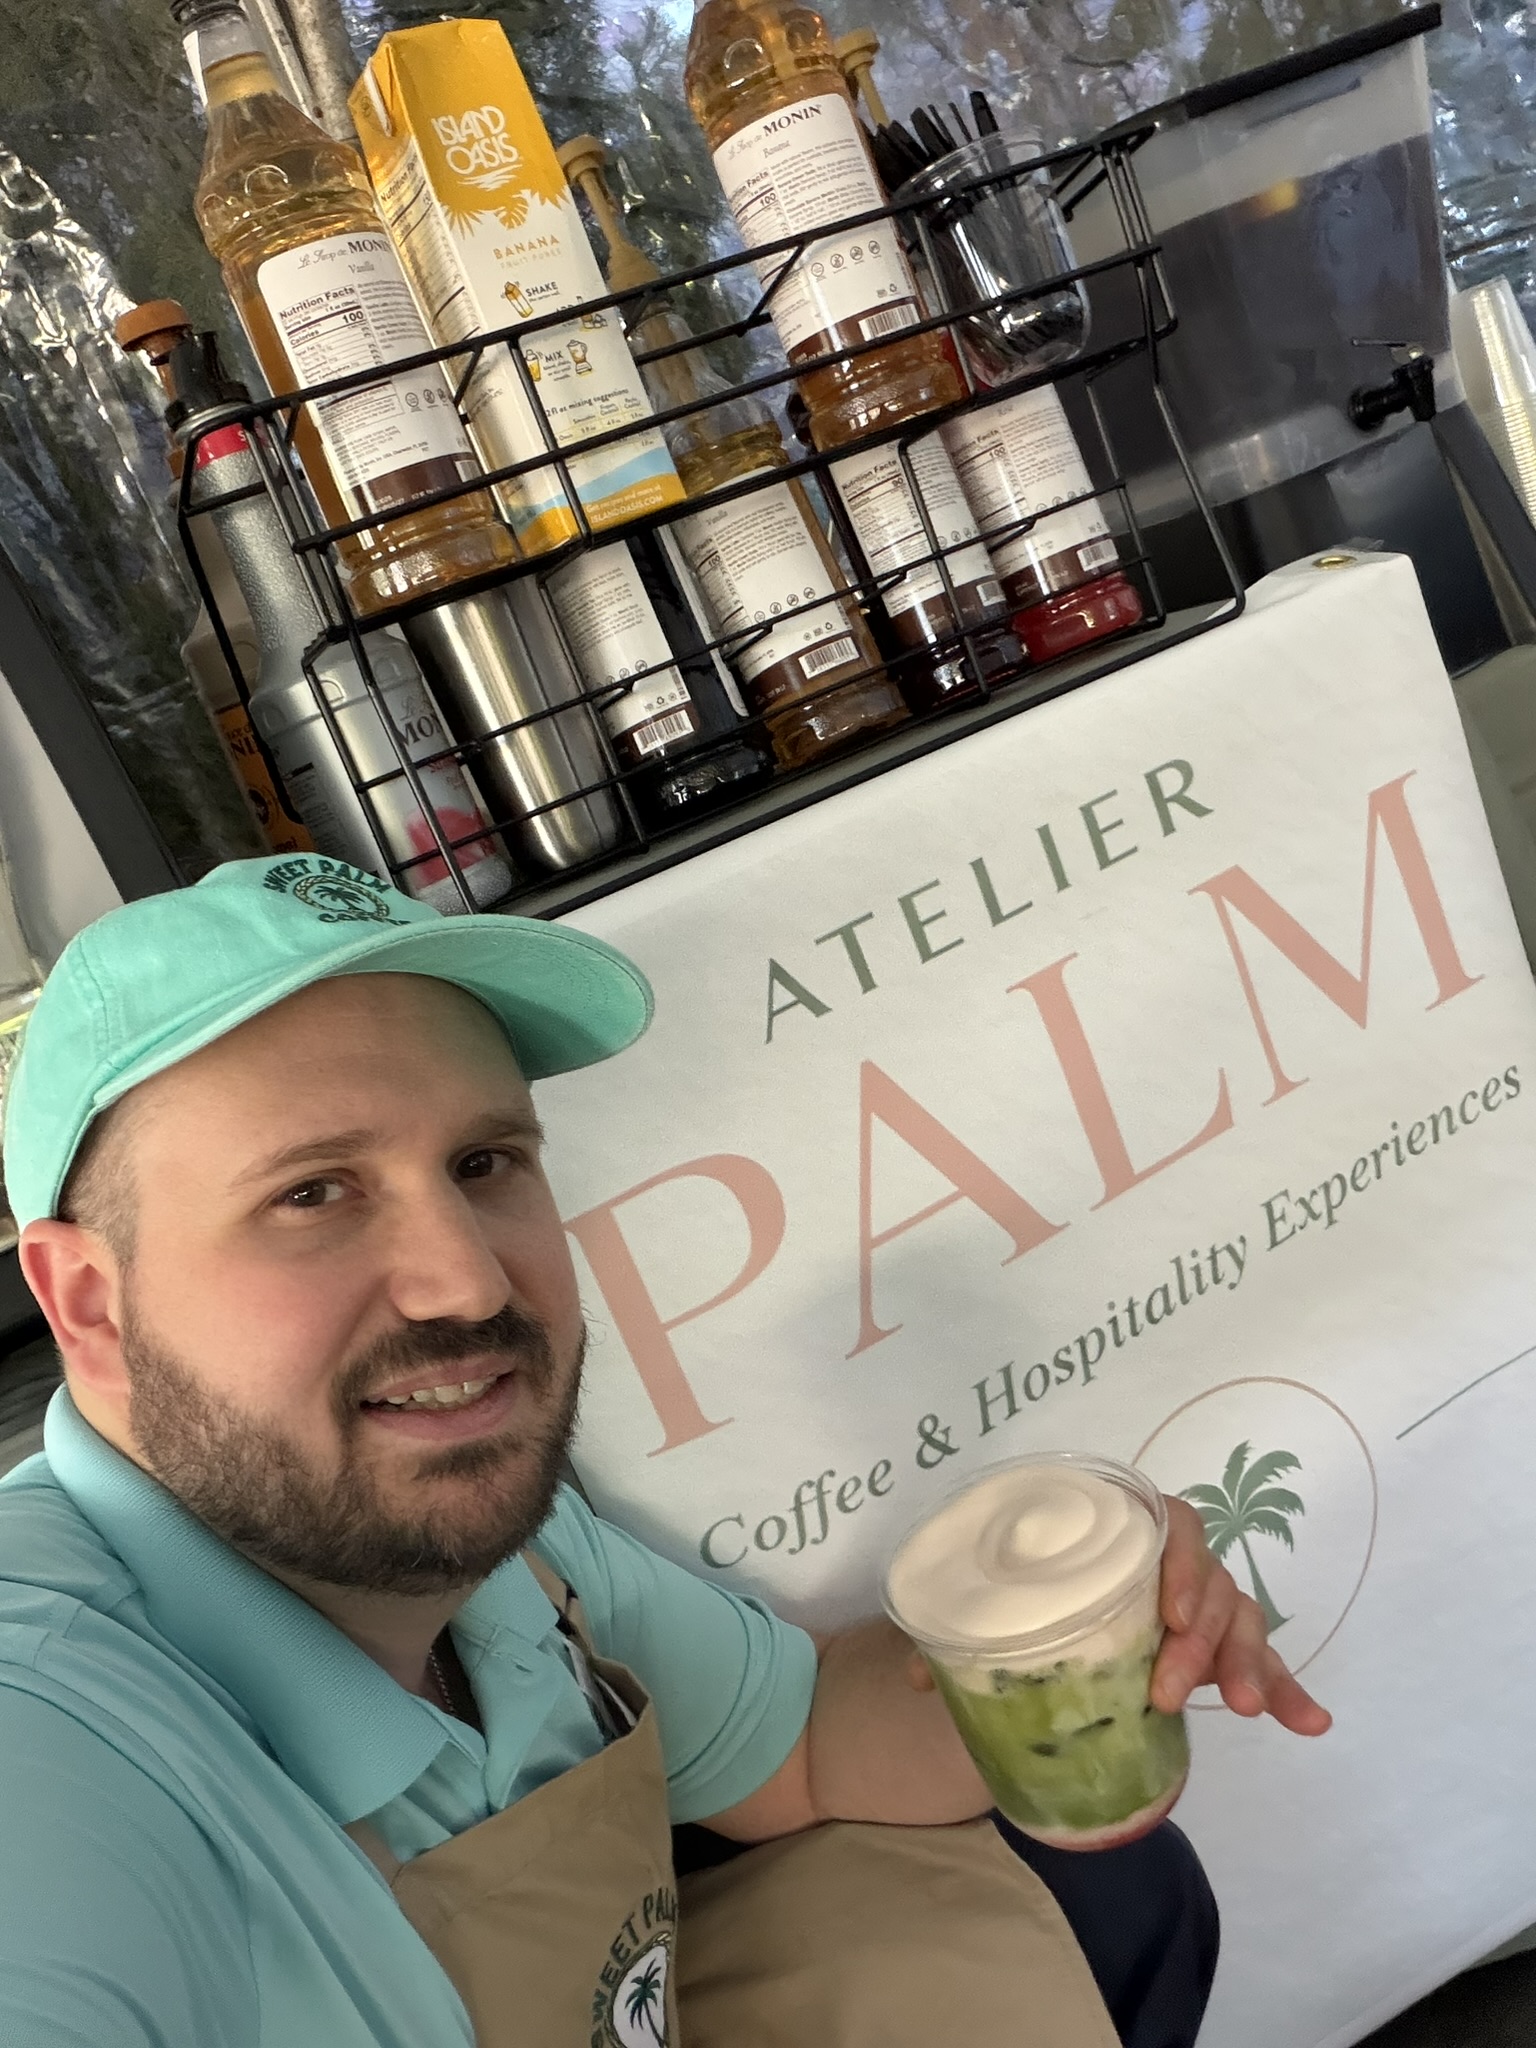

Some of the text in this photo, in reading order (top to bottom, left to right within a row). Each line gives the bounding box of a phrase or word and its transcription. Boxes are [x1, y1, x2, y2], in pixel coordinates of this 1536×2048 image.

[431, 105, 506, 146] ISLAND
[762, 104, 822, 137] MONIN
[446, 132, 518, 174] OASIS
[759, 192, 777, 208] 100
[493, 234, 560, 260] BANANA
[280, 286, 355, 320] Nutrition Facts
[525, 281, 558, 297] SHAKE
[290, 310, 364, 346] Calories 100
[545, 350, 564, 363] MIX
[263, 858, 393, 894] SWEET PALM
[766, 758, 1214, 1044] ATELIER
[560, 770, 1486, 1458] PALM
[700, 1064, 1523, 1569] Coffee & Hospitality Experiences
